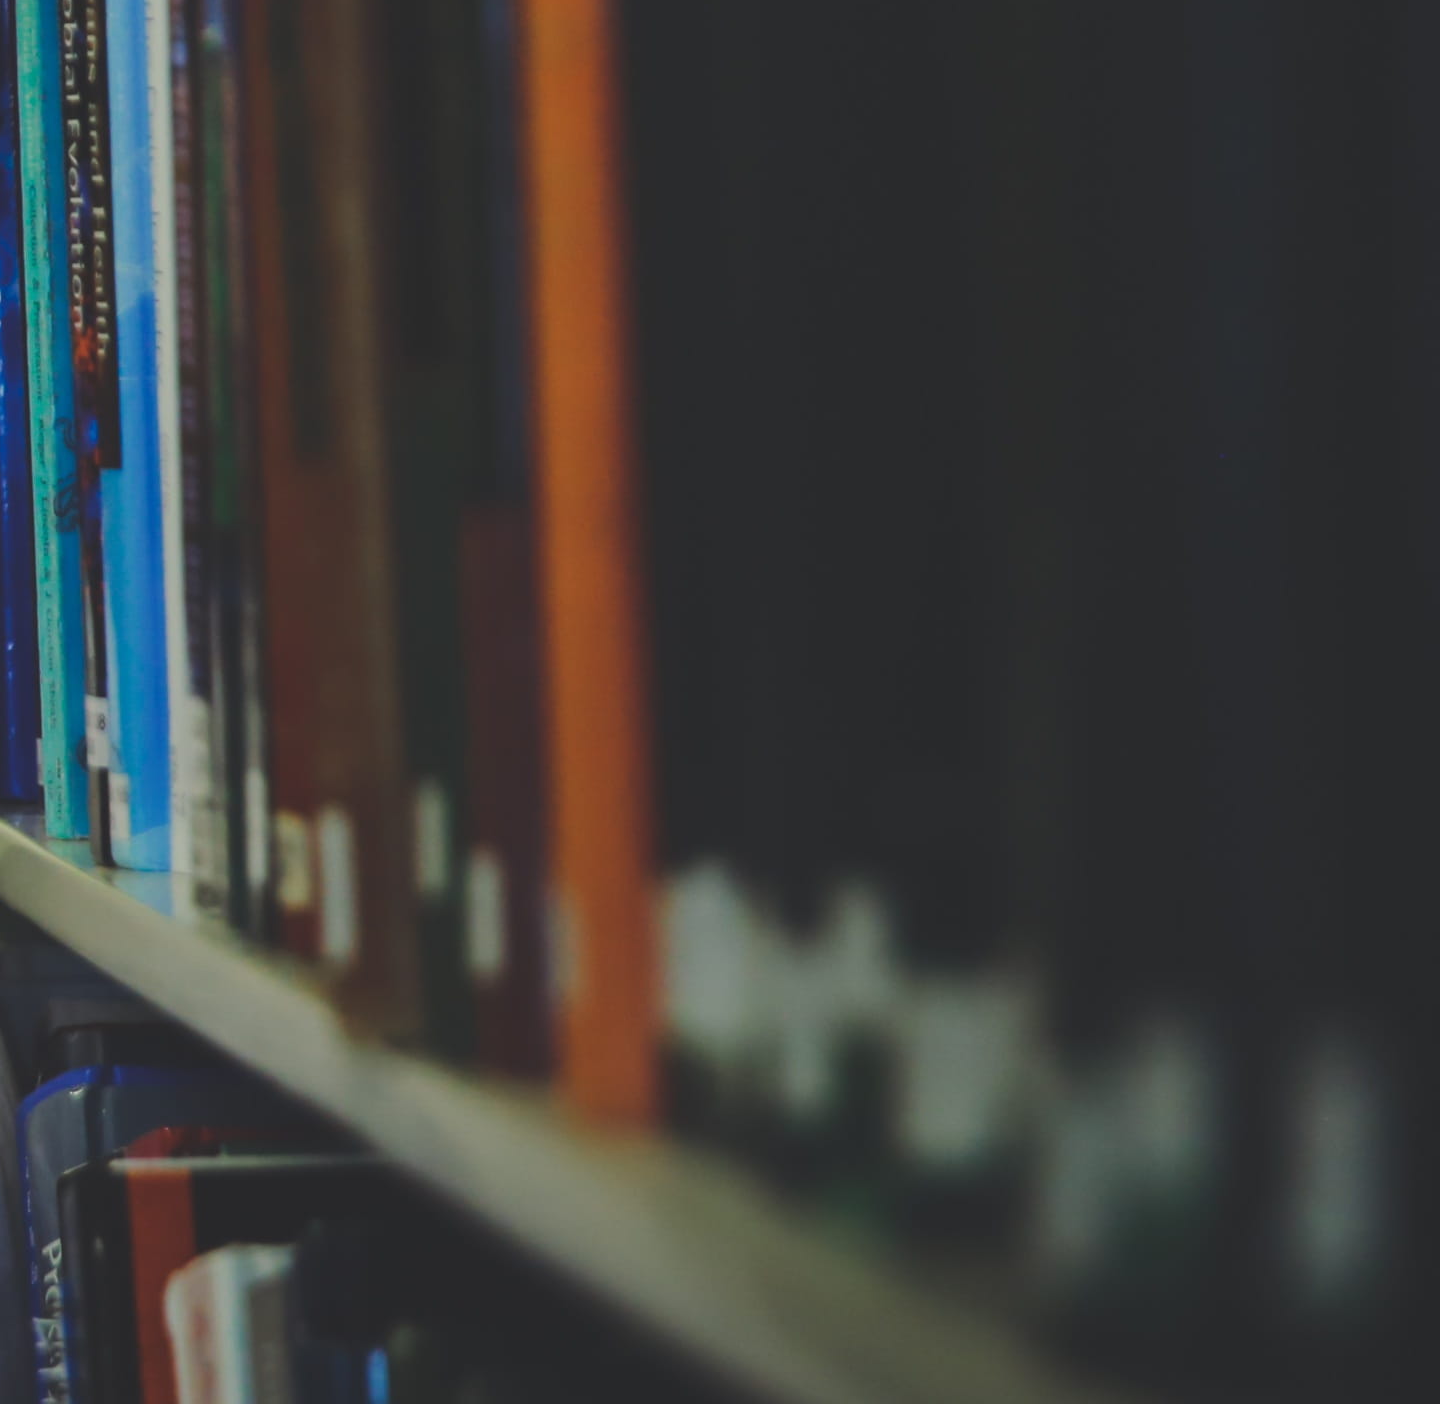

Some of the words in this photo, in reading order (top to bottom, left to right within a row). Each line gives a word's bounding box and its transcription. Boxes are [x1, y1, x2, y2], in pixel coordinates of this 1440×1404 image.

[88, 103, 105, 185] and
[28, 182, 39, 266] Collection
[65, 120, 86, 331] Evolution
[91, 206, 111, 358] Health
